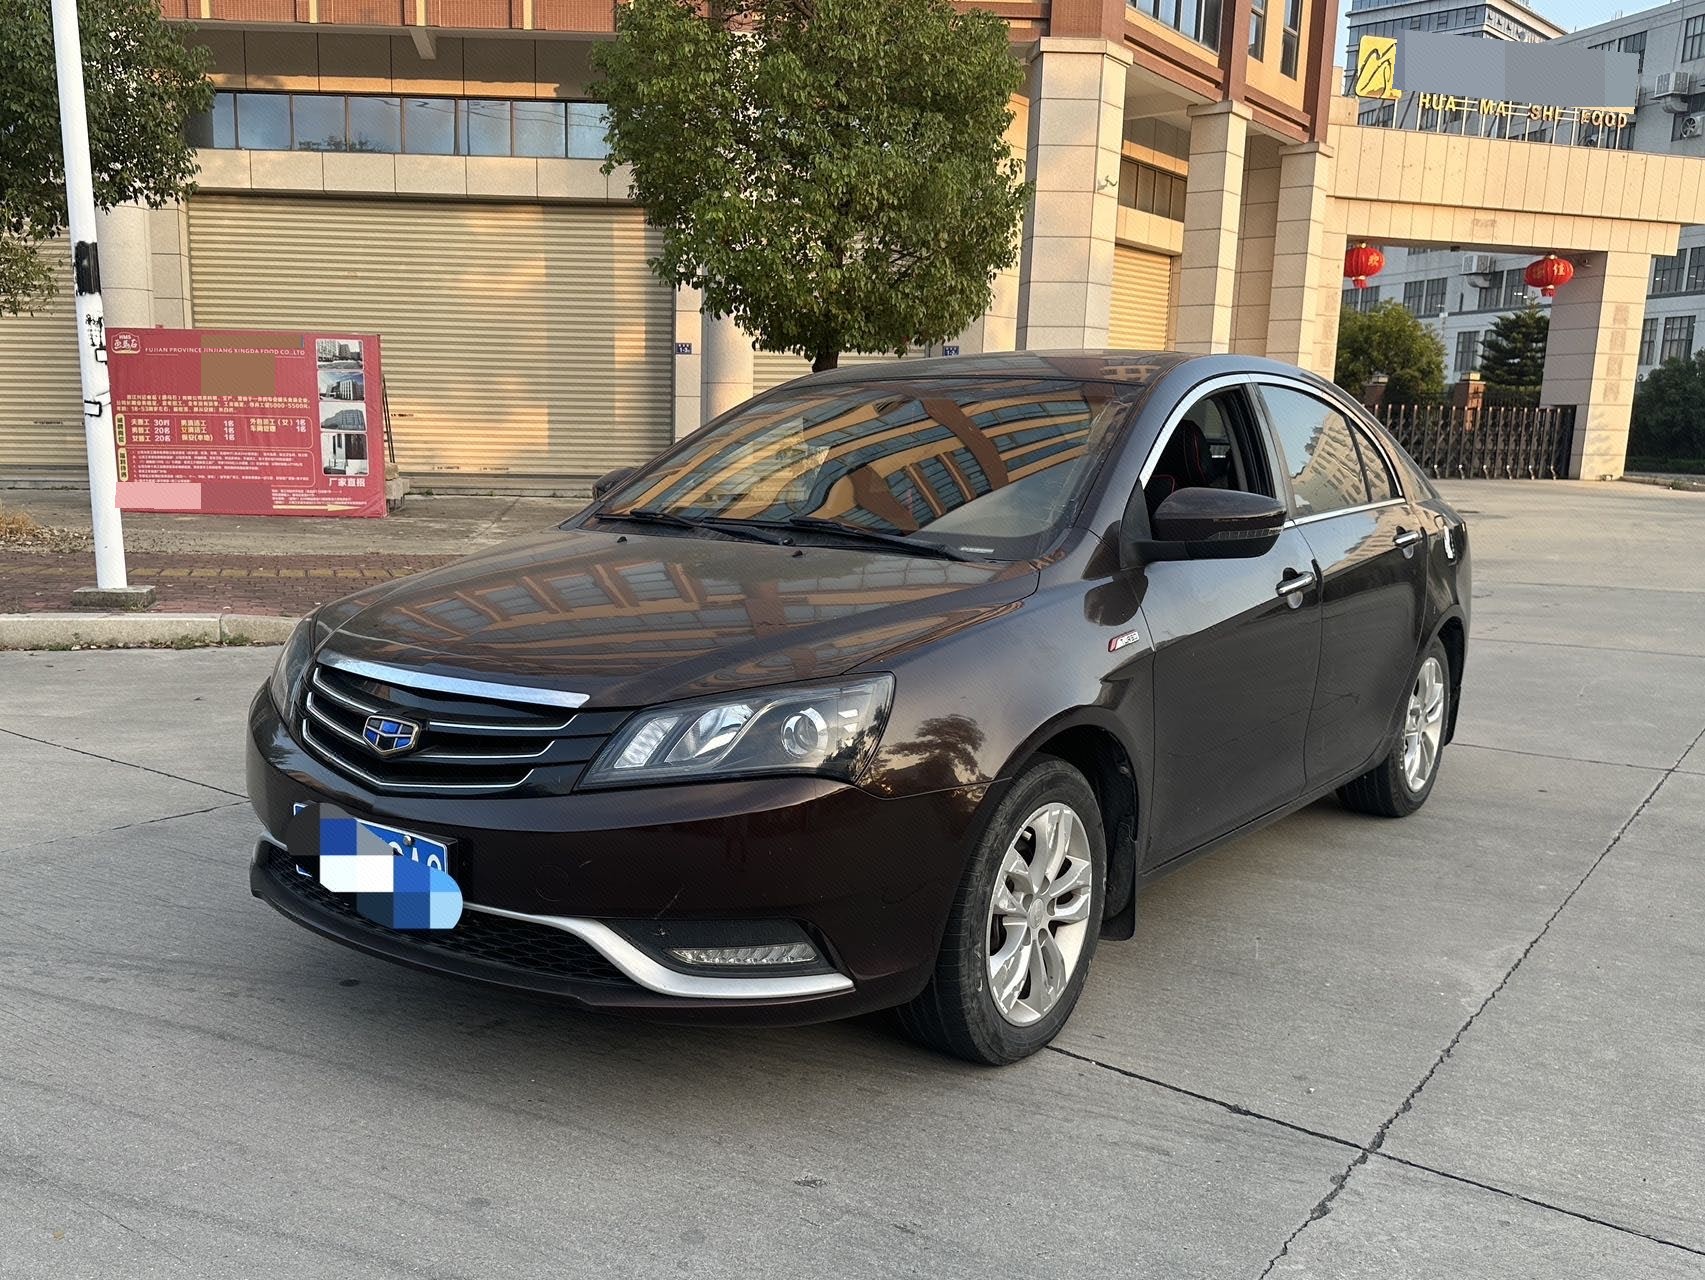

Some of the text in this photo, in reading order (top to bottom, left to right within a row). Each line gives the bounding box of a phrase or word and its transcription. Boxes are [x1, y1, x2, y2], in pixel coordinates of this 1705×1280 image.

[1420, 92, 1456, 111] HUA
[1480, 98, 1506, 116] MA
[1581, 110, 1627, 128] FOOD
